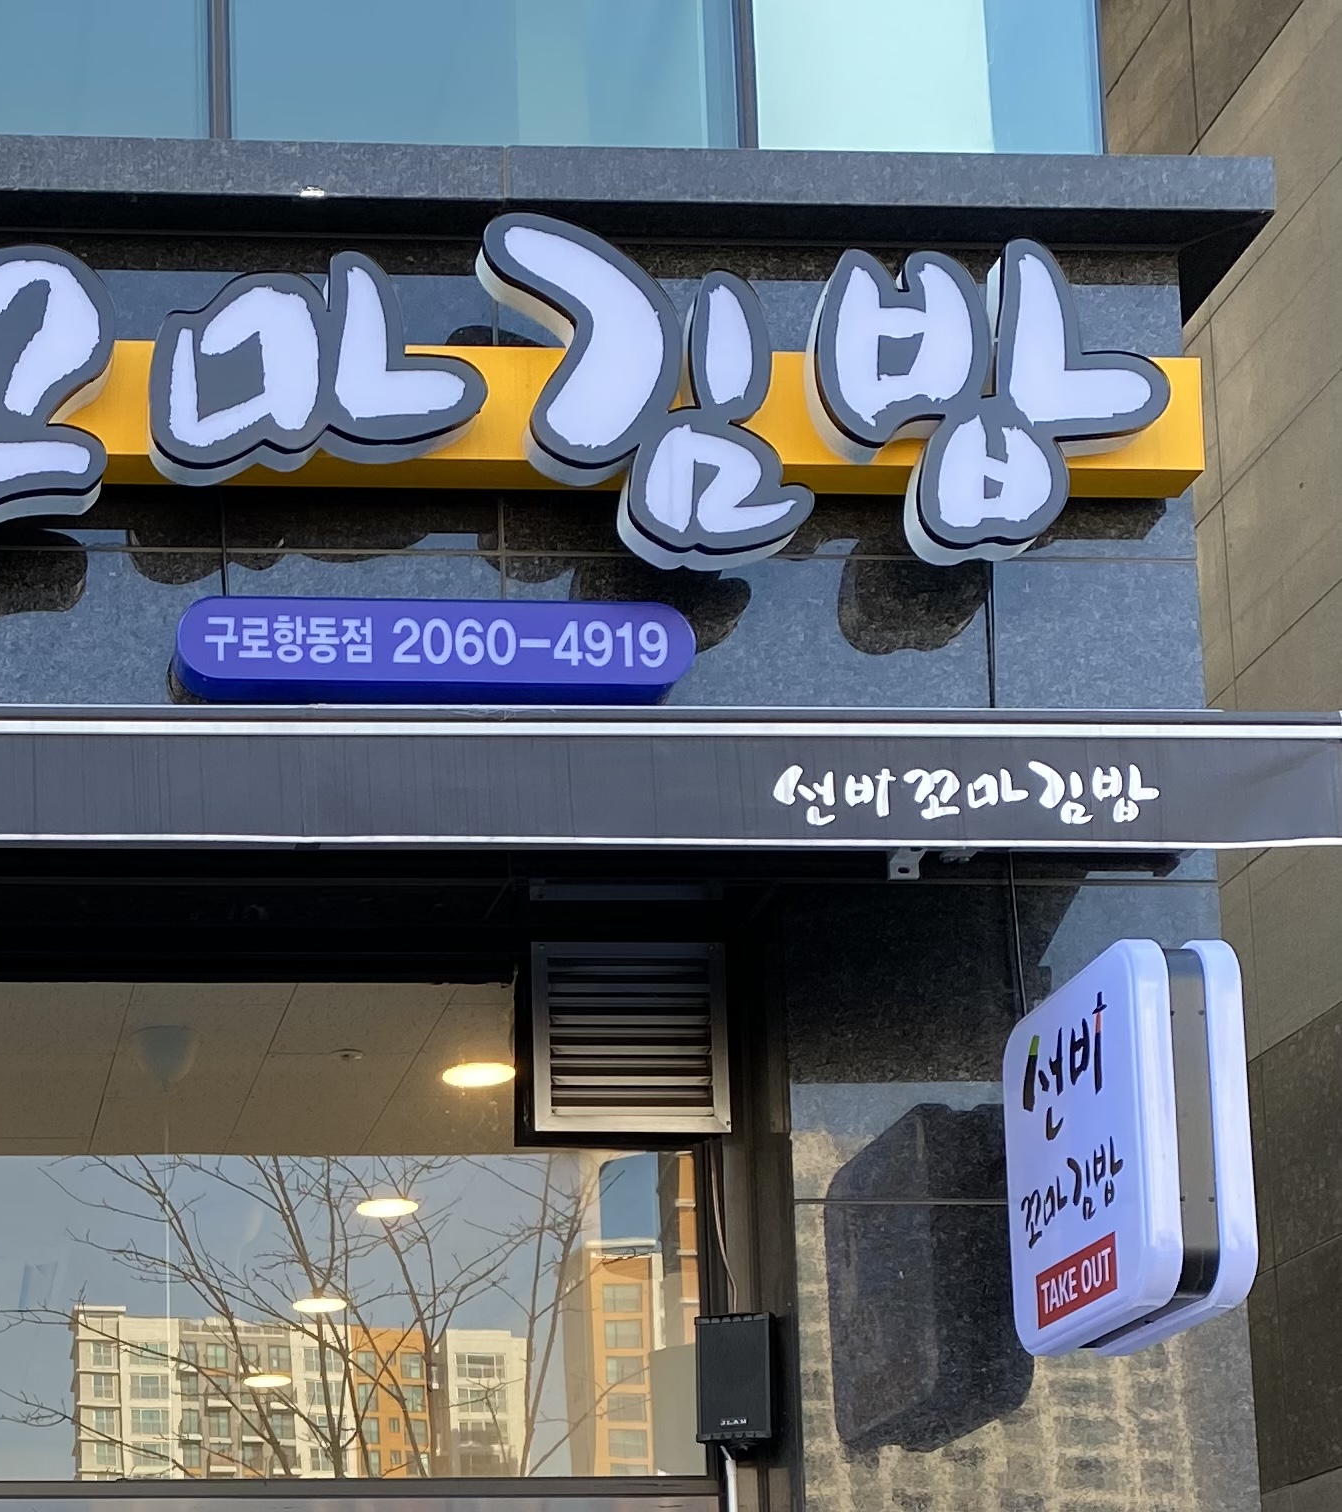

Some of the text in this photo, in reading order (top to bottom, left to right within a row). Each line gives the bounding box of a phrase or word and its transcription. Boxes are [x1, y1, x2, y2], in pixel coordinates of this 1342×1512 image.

[203, 614, 670, 668] 구로항동점 2060-4919
[1022, 990, 1108, 1142] 선비
[1020, 1135, 1124, 1250] 꼬마김밥
[1039, 1246, 1113, 1315] TAKE OUT
